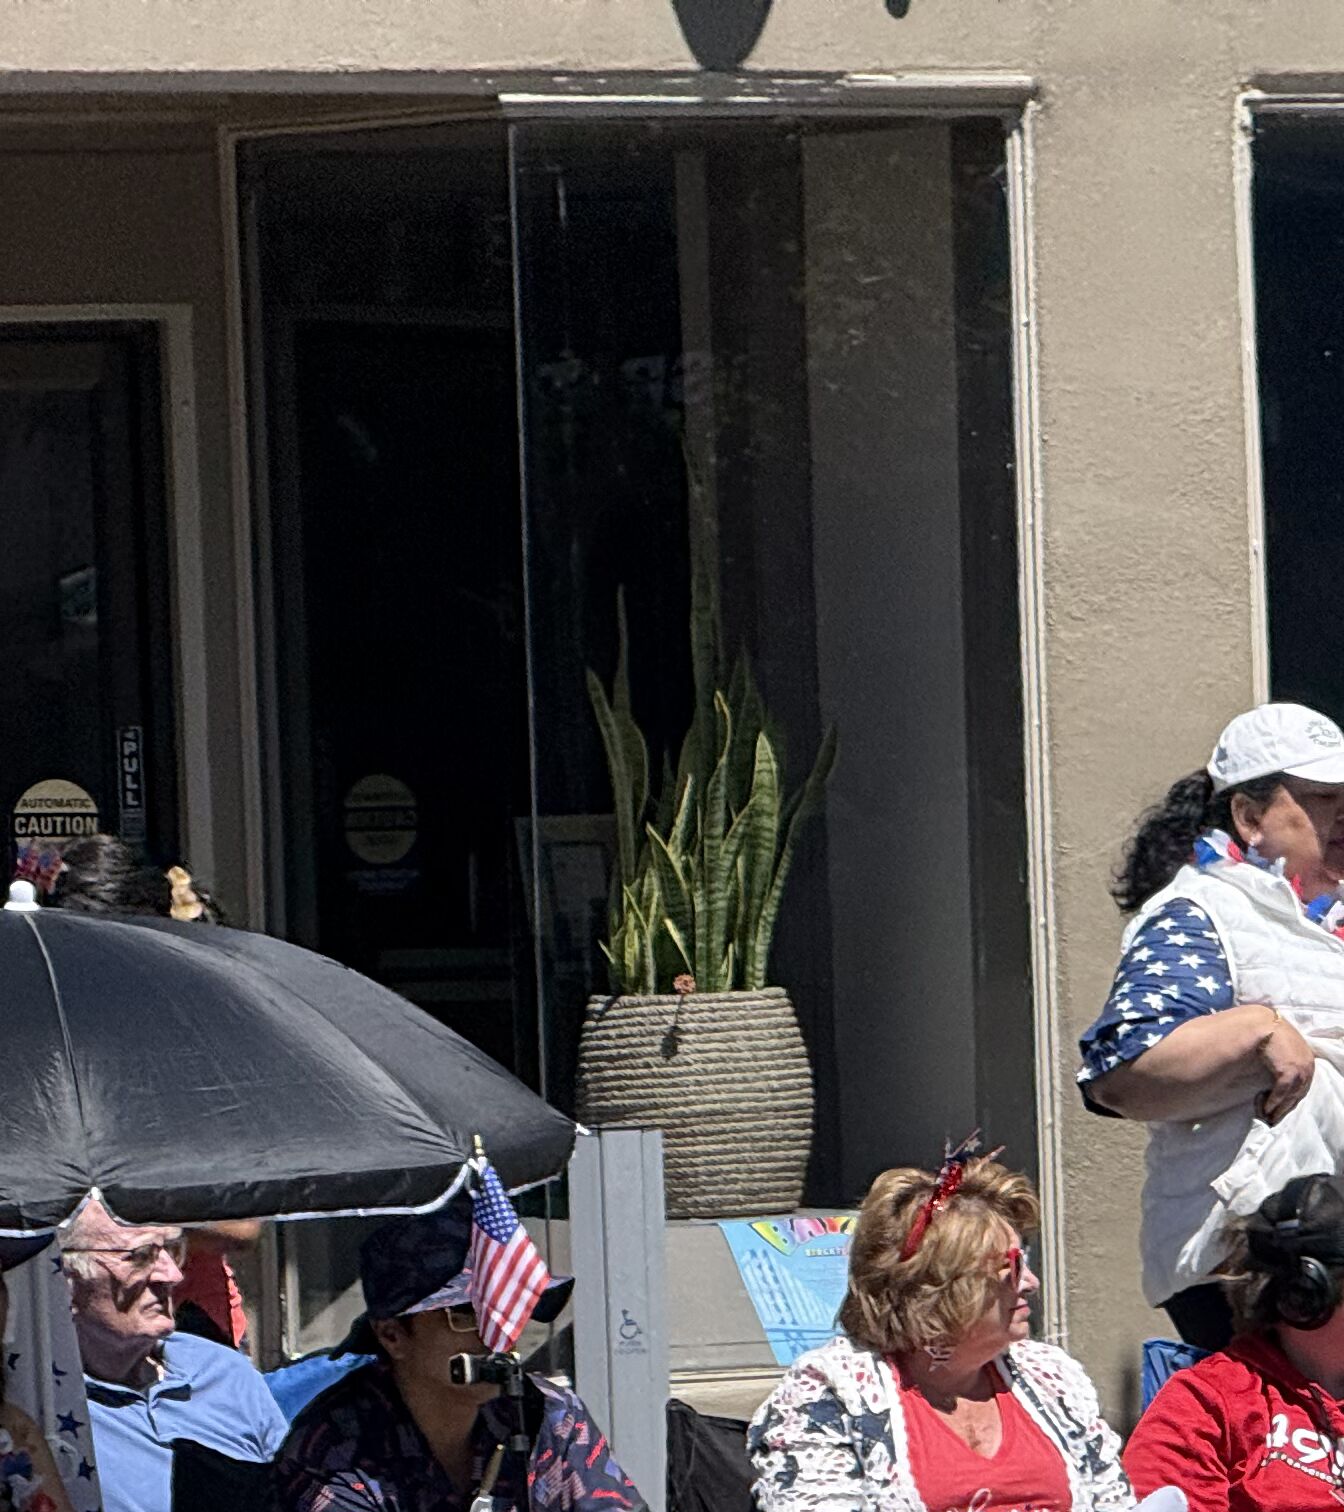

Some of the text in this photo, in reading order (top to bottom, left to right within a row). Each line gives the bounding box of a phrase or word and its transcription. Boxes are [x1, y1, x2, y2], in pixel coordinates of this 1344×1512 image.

[123, 741, 139, 806] PULL
[20, 798, 91, 809] AUTOMATIC
[14, 816, 98, 835] CAUTION
